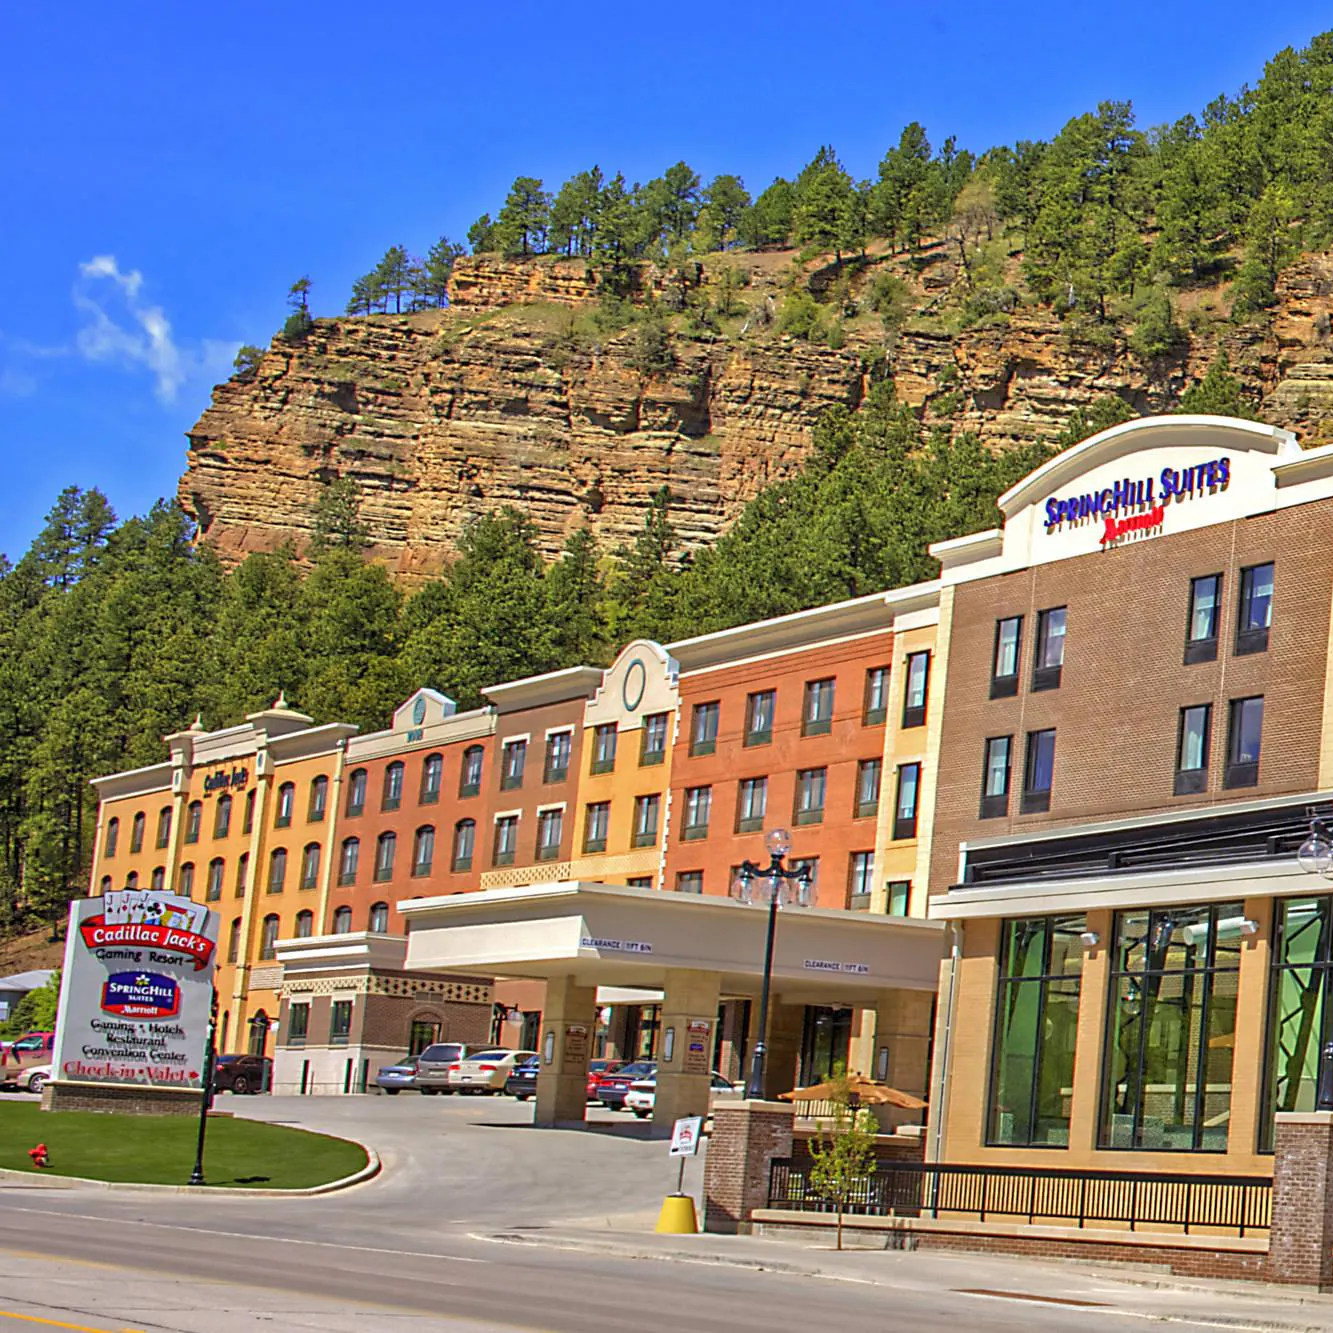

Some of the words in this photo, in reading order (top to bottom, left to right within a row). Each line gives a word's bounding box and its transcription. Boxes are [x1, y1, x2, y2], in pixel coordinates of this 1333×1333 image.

[93, 926, 160, 943] Cadillac
[163, 929, 206, 952] Jack's
[96, 948, 142, 963] Gaming
[149, 951, 185, 966] Resort
[127, 994, 155, 1003] SUITES
[90, 1018, 136, 1034] Gaming
[148, 1023, 186, 1035] Hotels
[105, 1033, 166, 1047] Restaurant
[81, 1044, 147, 1059] Convention
[149, 1049, 187, 1062] Center
[63, 1060, 136, 1079] Check-in
[145, 1066, 185, 1081] Valet
